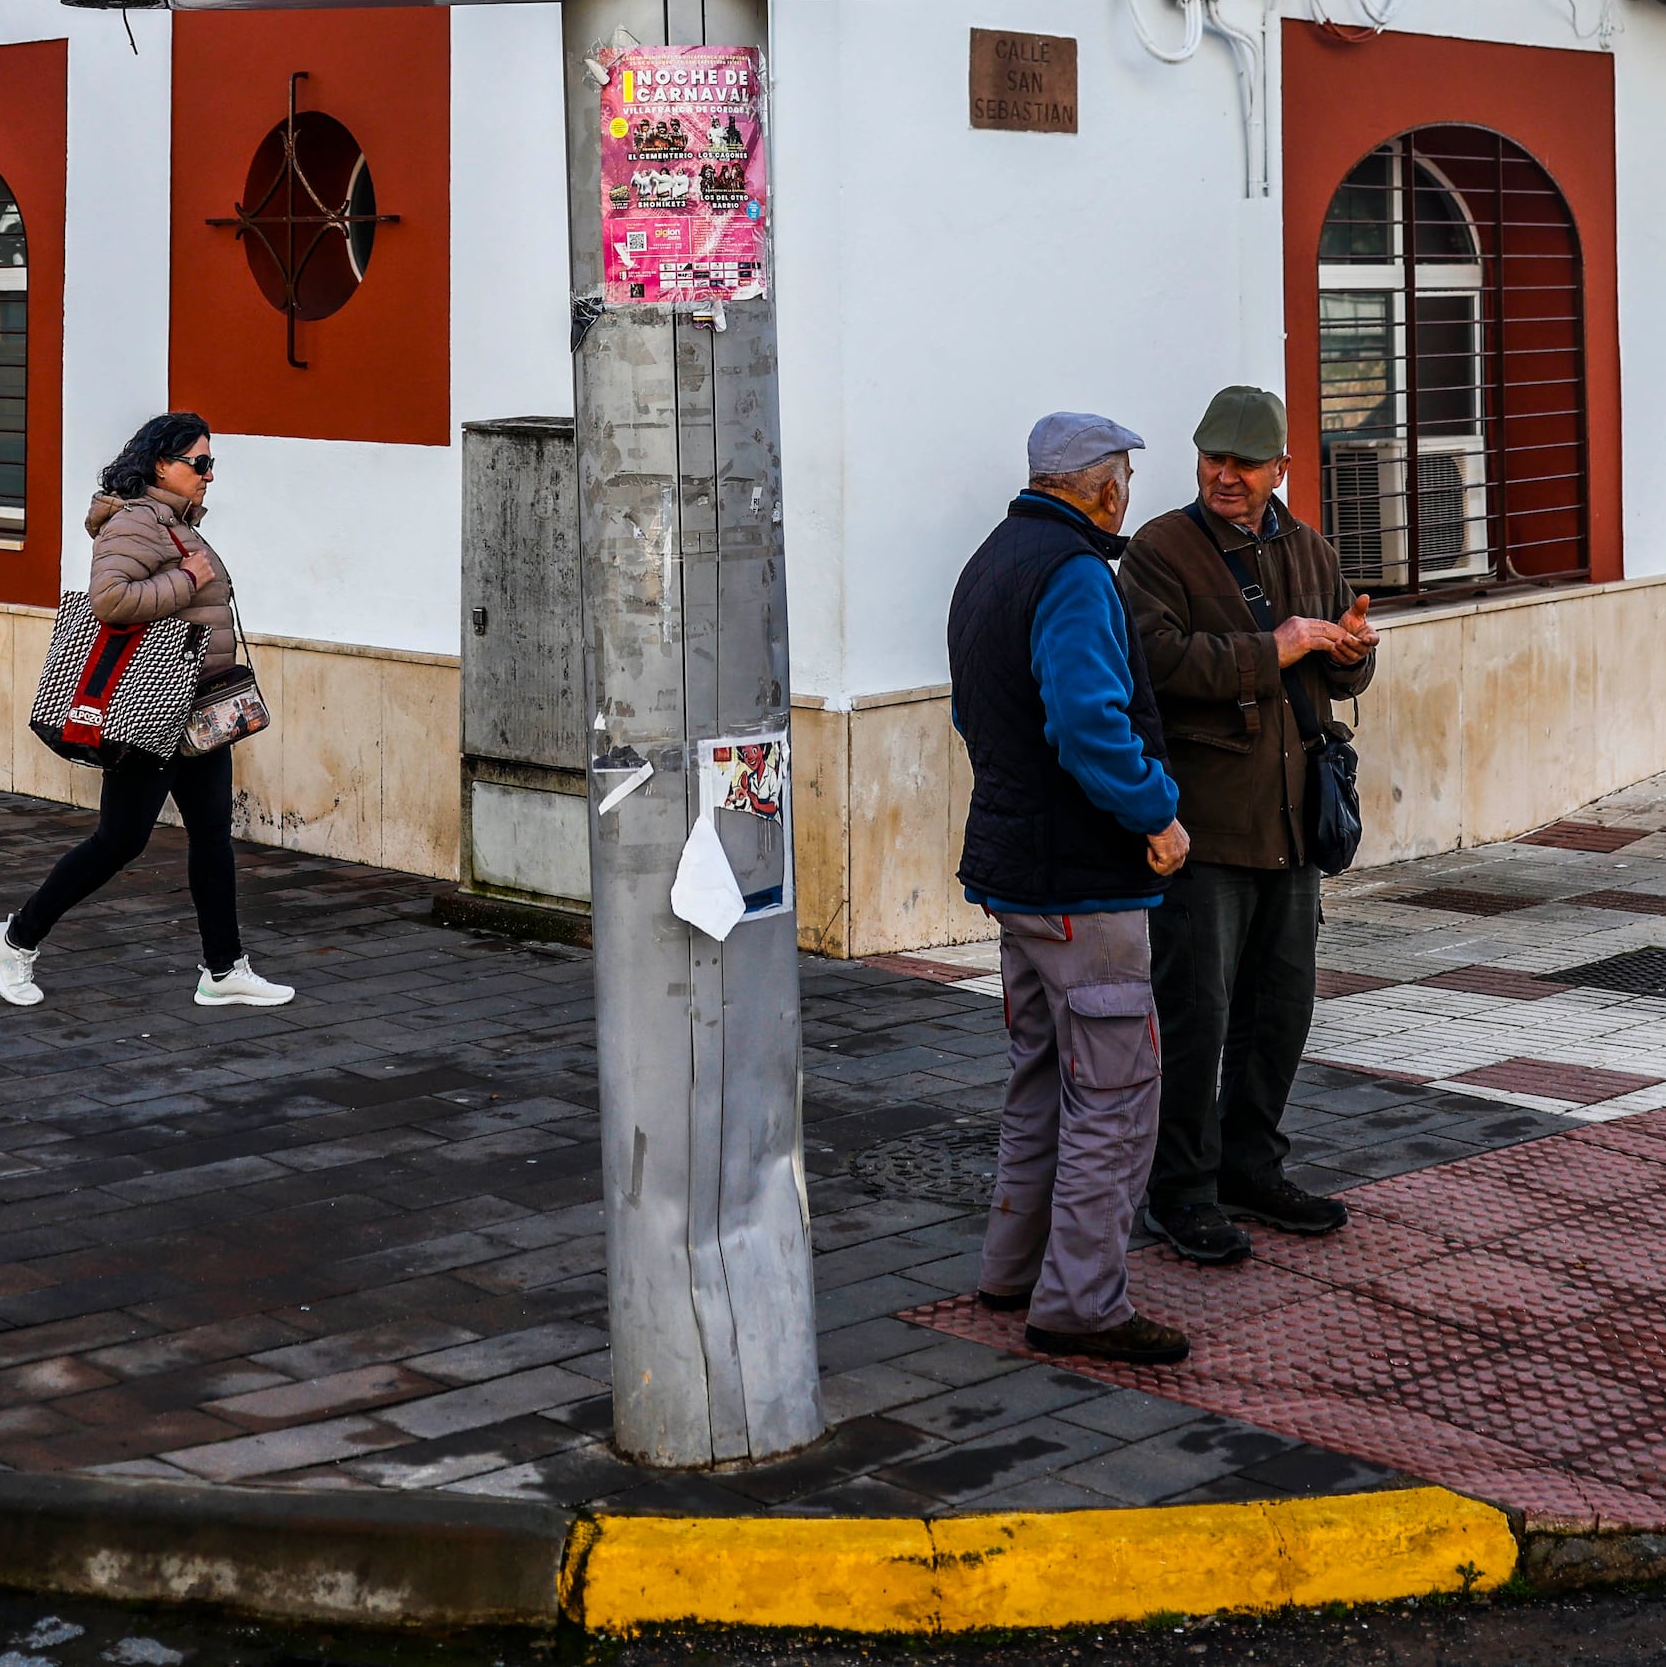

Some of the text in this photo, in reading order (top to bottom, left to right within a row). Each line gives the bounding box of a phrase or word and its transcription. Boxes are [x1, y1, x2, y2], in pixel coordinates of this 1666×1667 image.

[995, 40, 1050, 63] CALLE
[636, 69, 749, 86] NOCHE DE
[1007, 70, 1043, 93] SAN
[636, 87, 749, 103] CARNAVAL
[623, 105, 693, 115] VILLAFRANCA
[696, 106, 709, 114] DE
[974, 98, 1073, 124] SEBASTIAN
[628, 152, 694, 161] EL CEMENTERIO
[698, 152, 714, 160] LOS
[700, 194, 715, 202] LOS
